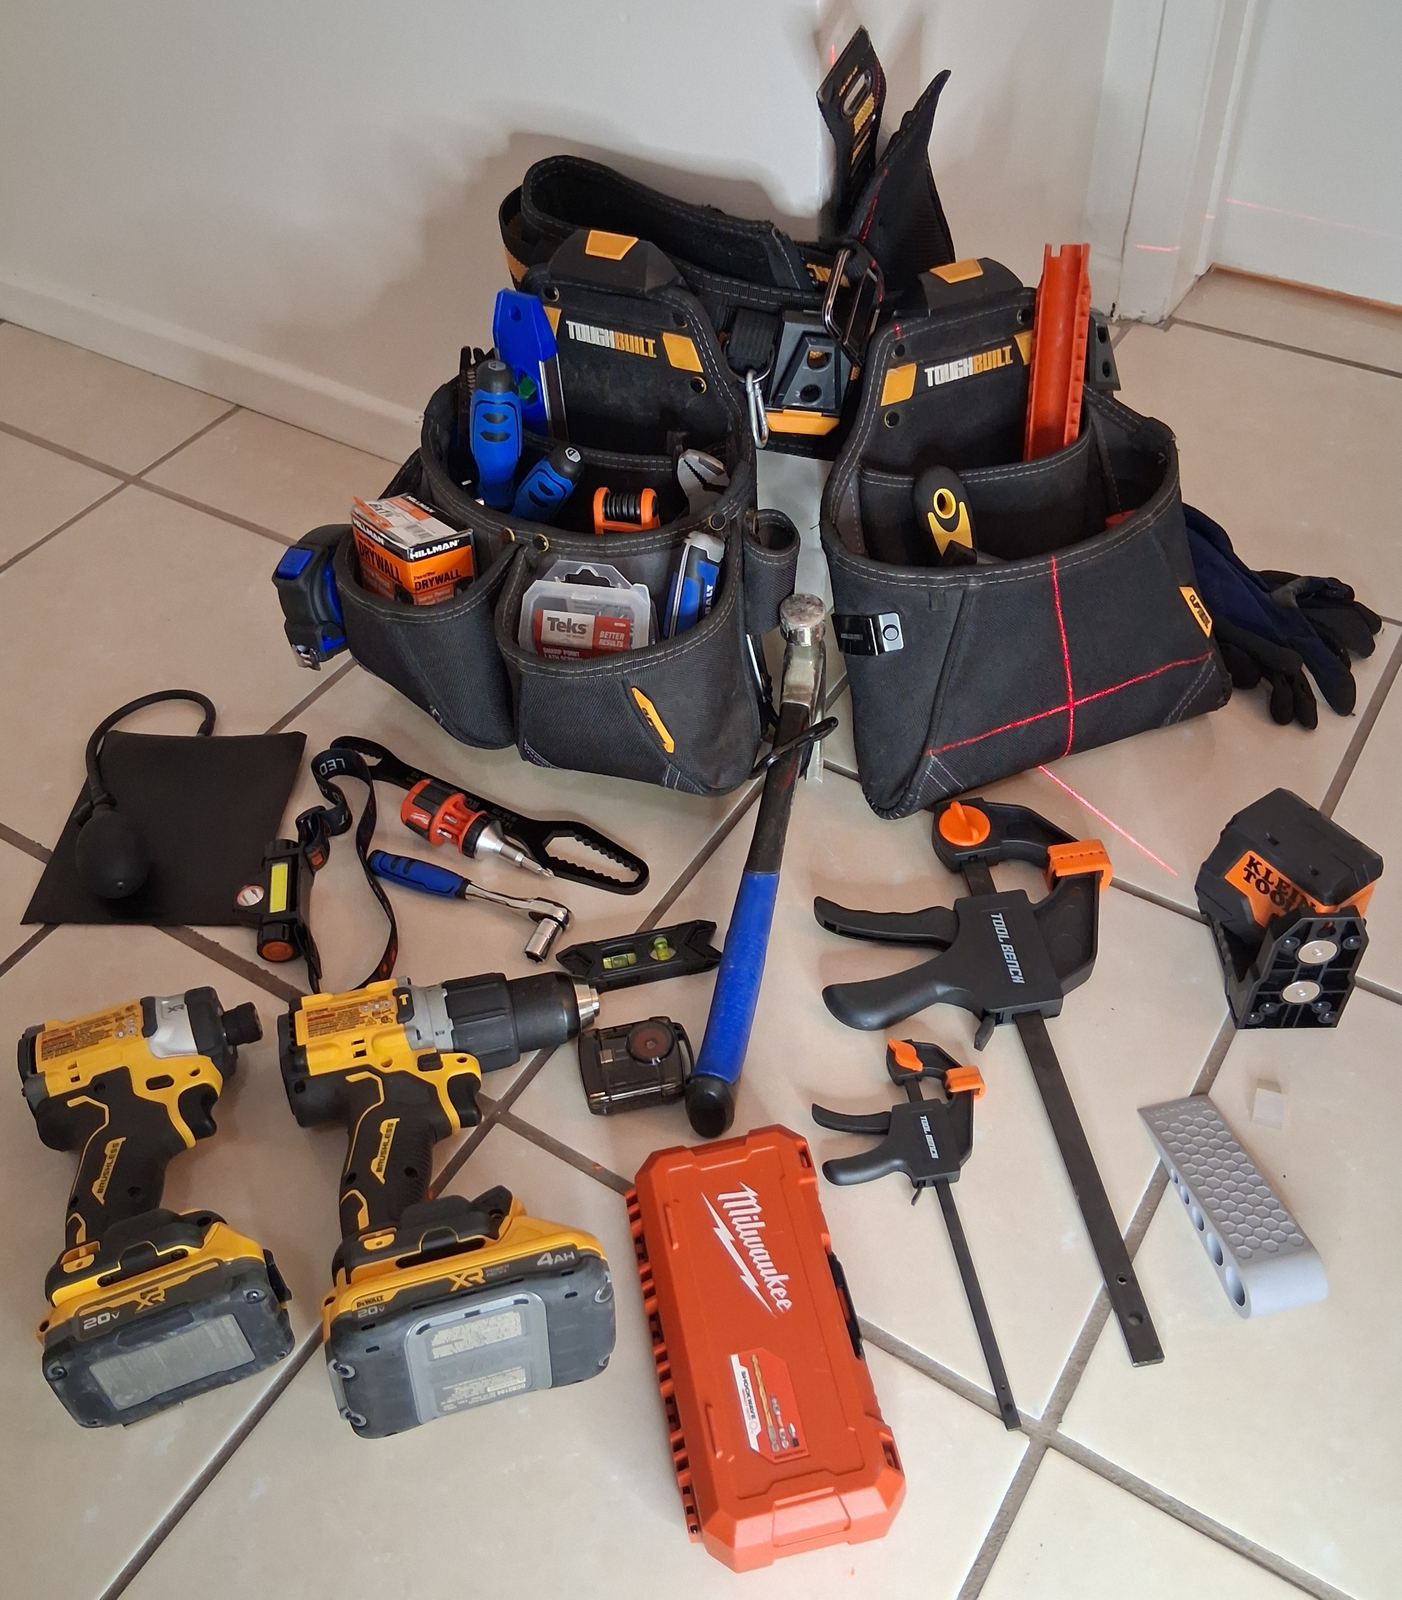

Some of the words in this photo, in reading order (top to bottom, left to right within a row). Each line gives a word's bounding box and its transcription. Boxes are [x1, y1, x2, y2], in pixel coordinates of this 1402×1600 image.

[566, 320, 657, 359] TOUGHBUILT
[924, 345, 1013, 387] TOUGHBUILT
[359, 542, 403, 585] DRYWALL
[410, 540, 460, 561] HILLMAN
[414, 569, 462, 592] DRYWALL
[546, 616, 588, 635] Teks
[599, 630, 626, 641] BETTER
[320, 757, 347, 776] LED
[990, 912, 1011, 943] TOOL
[1000, 944, 1026, 985] BENCH
[717, 1181, 793, 1313] Milwaukee
[448, 1267, 488, 1292] XR
